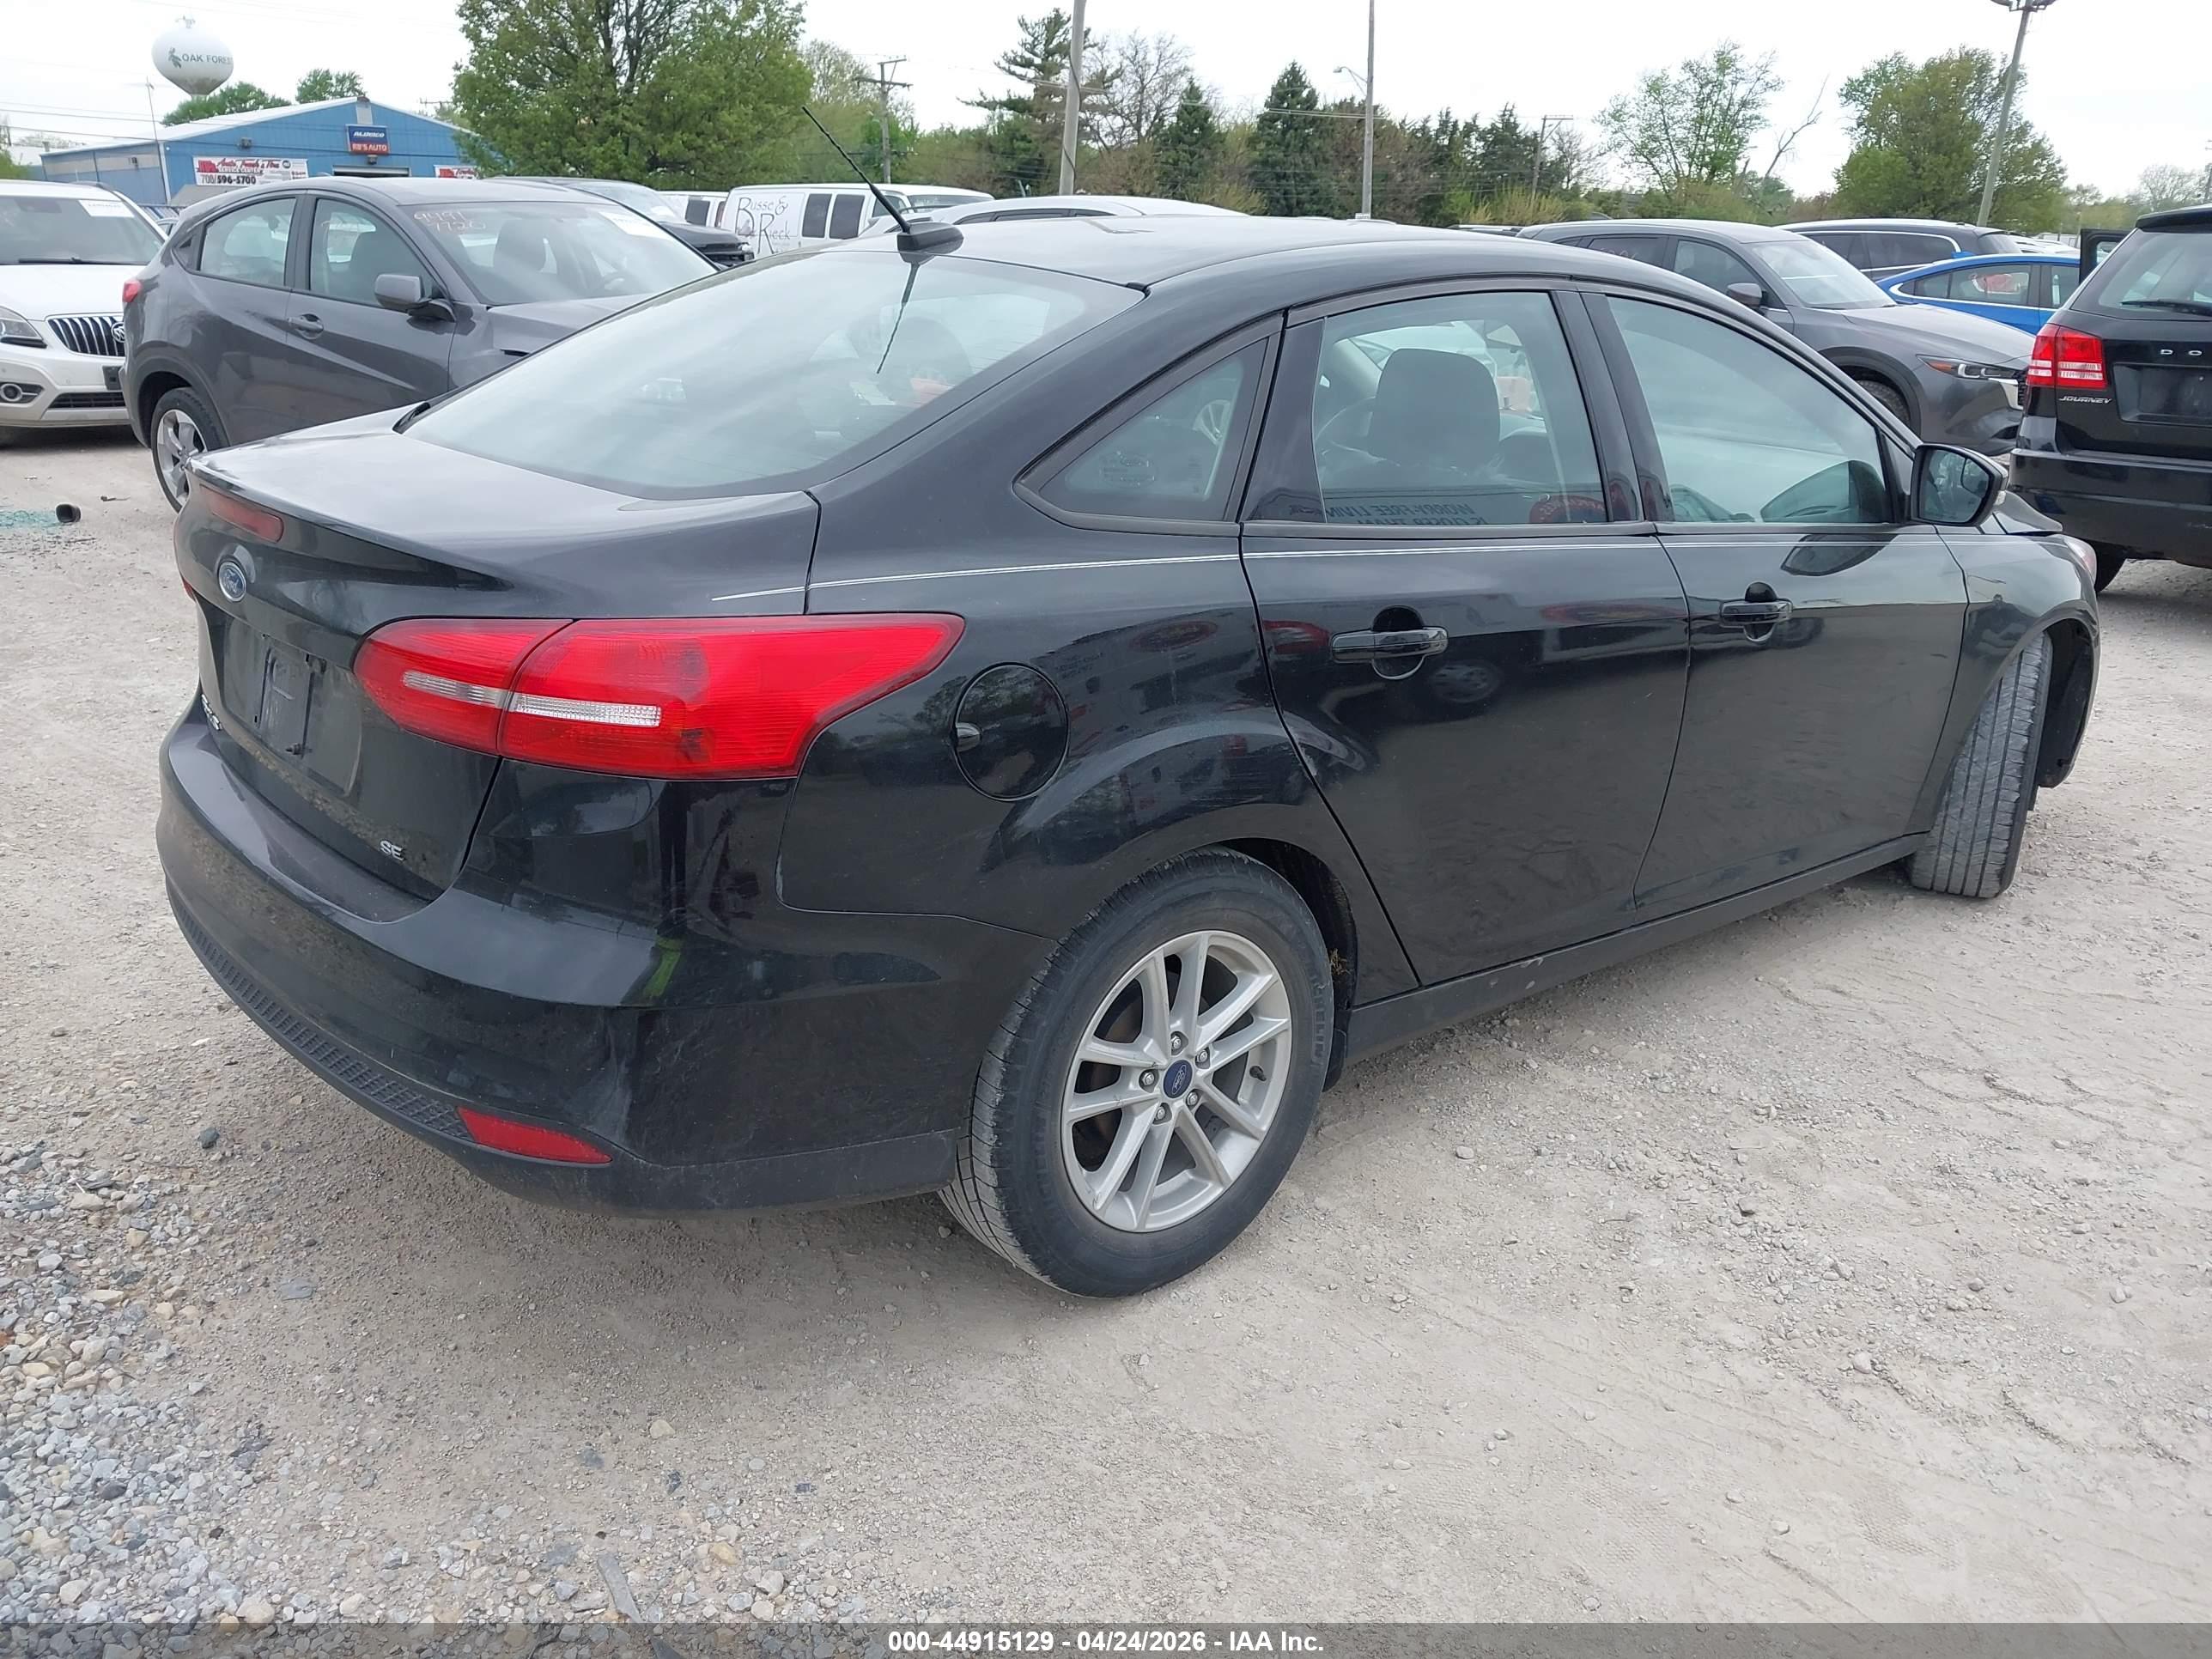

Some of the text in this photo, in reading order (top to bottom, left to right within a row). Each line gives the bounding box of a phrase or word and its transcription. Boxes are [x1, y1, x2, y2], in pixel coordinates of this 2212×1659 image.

[181, 53, 204, 62] OAK
[2058, 396, 2112, 404] JOURNEY
[380, 840, 404, 860] SE
